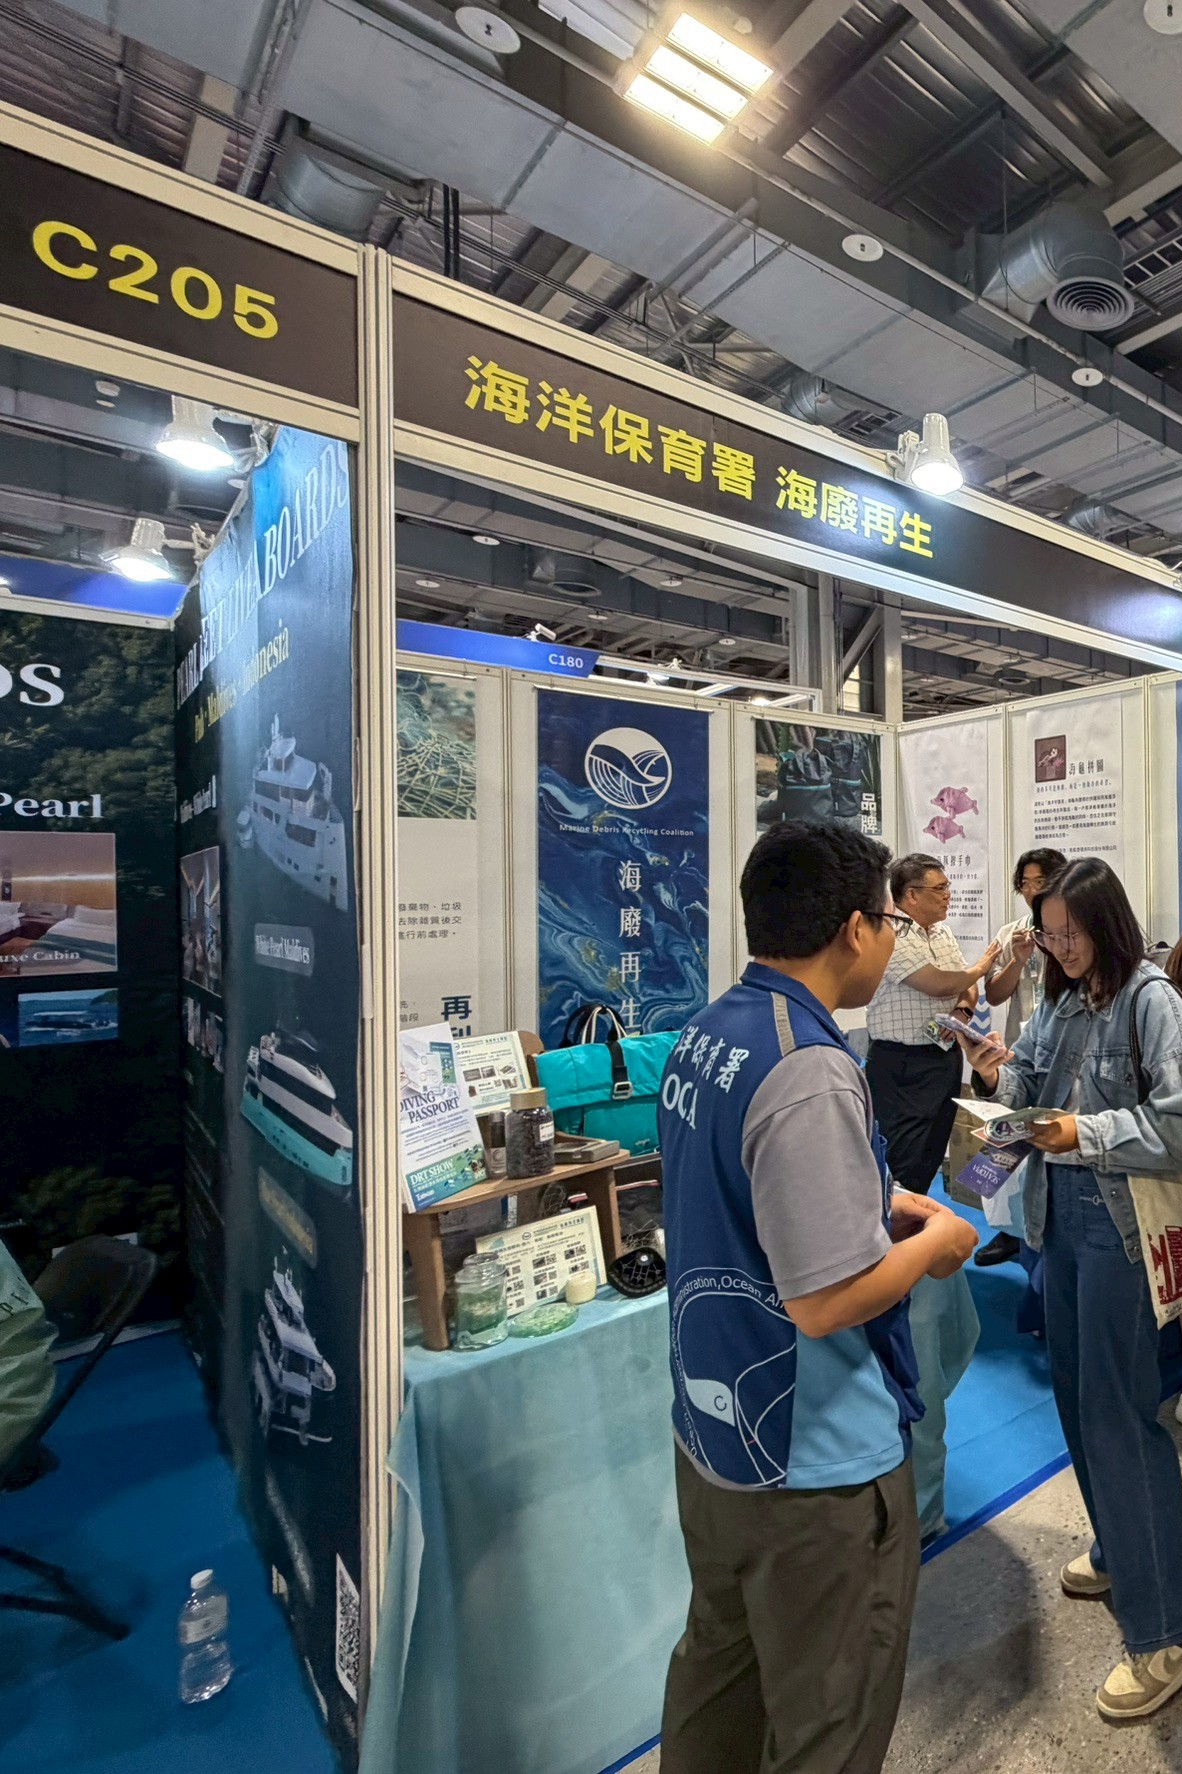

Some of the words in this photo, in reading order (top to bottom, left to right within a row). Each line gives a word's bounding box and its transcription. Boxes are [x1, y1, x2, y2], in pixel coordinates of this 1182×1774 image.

[32, 220, 279, 339] C205
[464, 355, 756, 500] 海洋保育署
[776, 466, 934, 558] 海廢再生
[548, 654, 584, 669] C180
[861, 792, 878, 834] 品牌
[559, 824, 590, 833] Marine
[592, 825, 619, 834] Debris
[622, 827, 658, 836] Recycling
[660, 828, 694, 837] Coalition
[33, 949, 80, 962] Cabin
[618, 859, 642, 1029] 海廢再生
[408, 1096, 460, 1124] PASSPORT
[410, 1170, 429, 1185] DRT
[429, 1158, 453, 1178] SHOW
